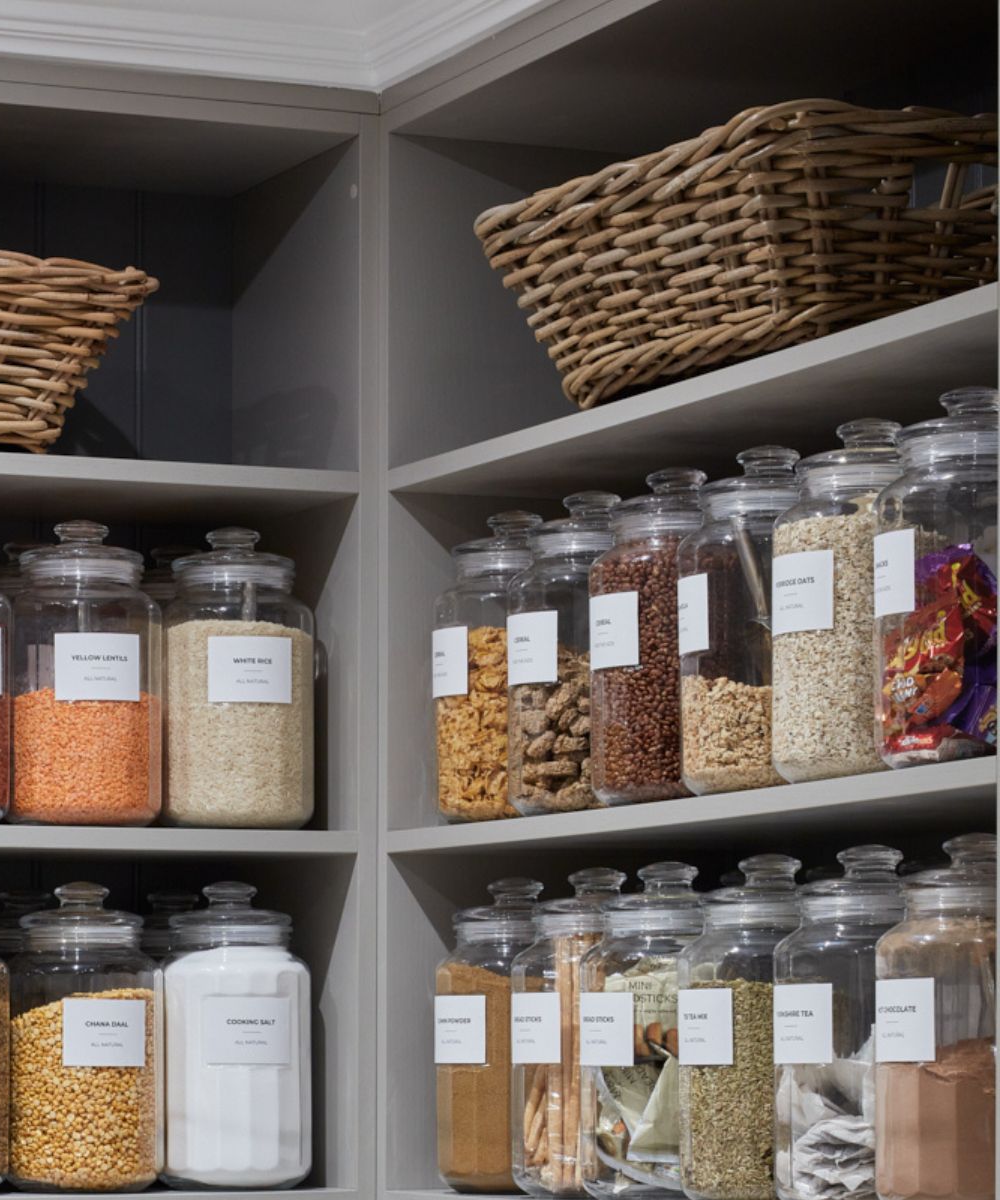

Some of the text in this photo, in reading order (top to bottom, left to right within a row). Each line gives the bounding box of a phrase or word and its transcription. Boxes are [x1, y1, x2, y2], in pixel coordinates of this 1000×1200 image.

[797, 576, 815, 585] OATS
[629, 981, 653, 991] MINI
[800, 1009, 814, 1017] TEA
[227, 1018, 276, 1026] COOKING SALT
